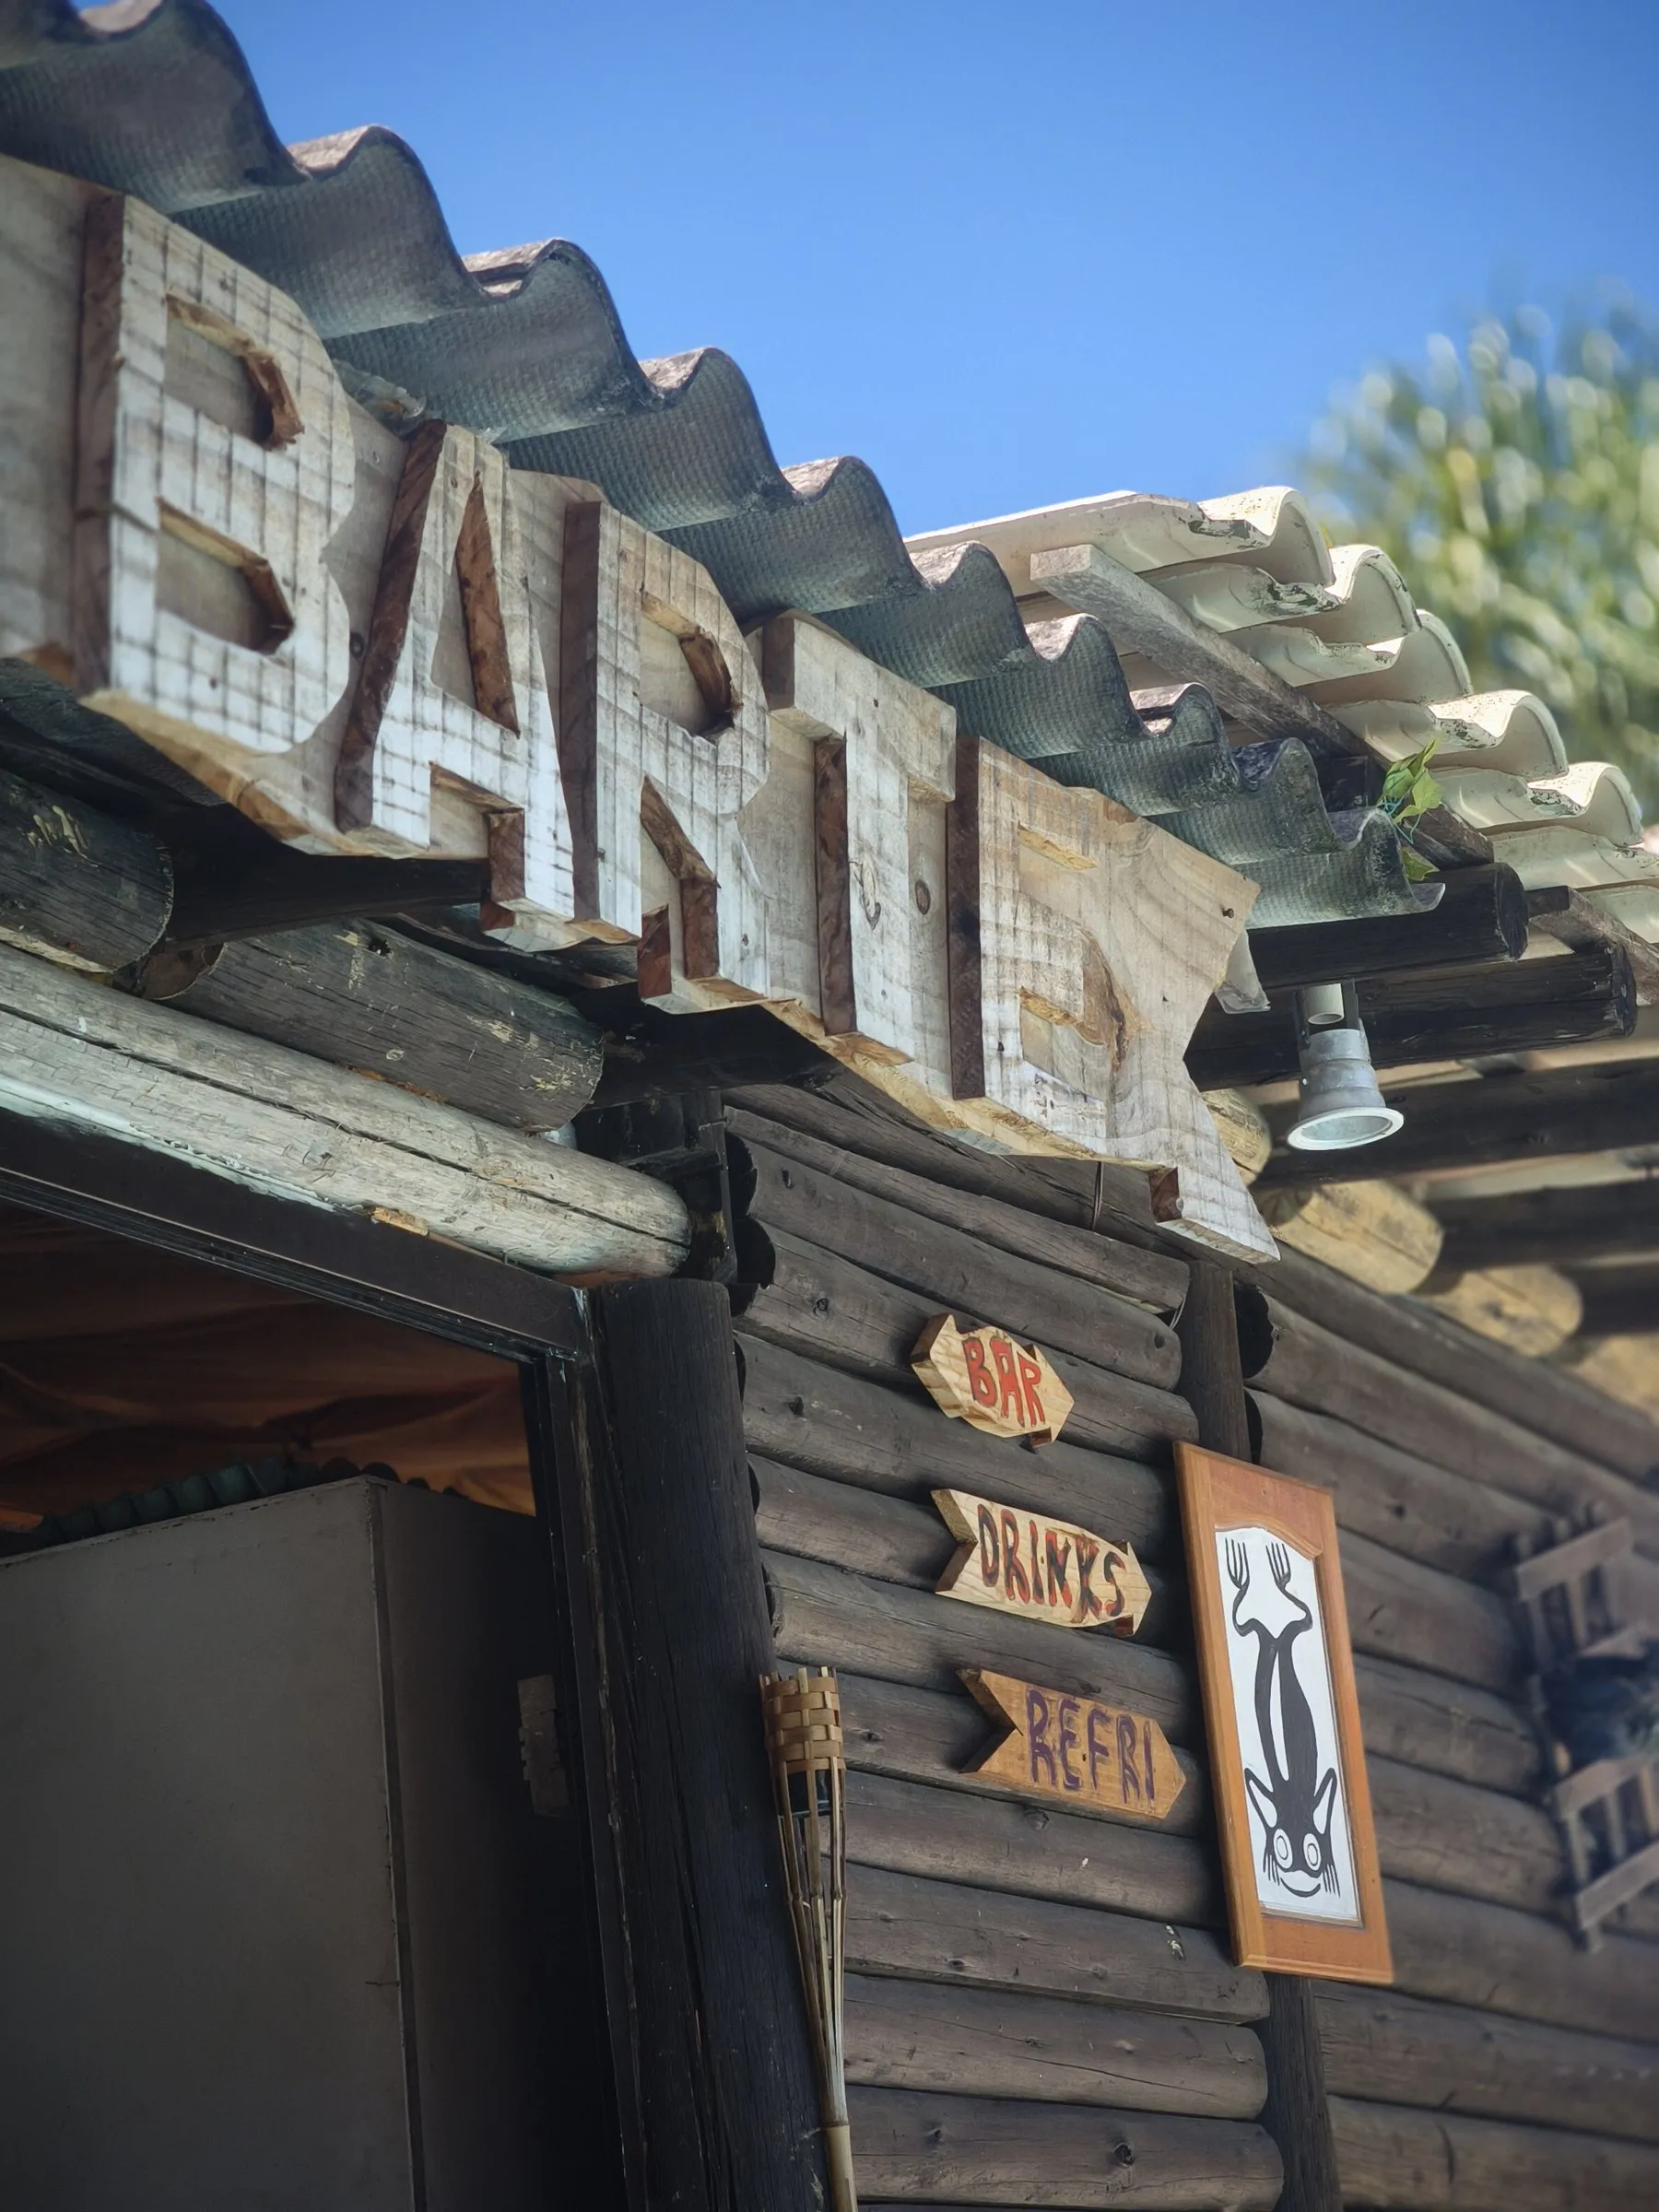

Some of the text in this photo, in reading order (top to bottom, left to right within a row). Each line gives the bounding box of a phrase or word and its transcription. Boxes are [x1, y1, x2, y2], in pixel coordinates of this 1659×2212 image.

[962, 1336, 1045, 1428] BAR
[978, 1504, 1125, 1618] DRINKS
[1027, 1689, 1156, 1803] REFRI
